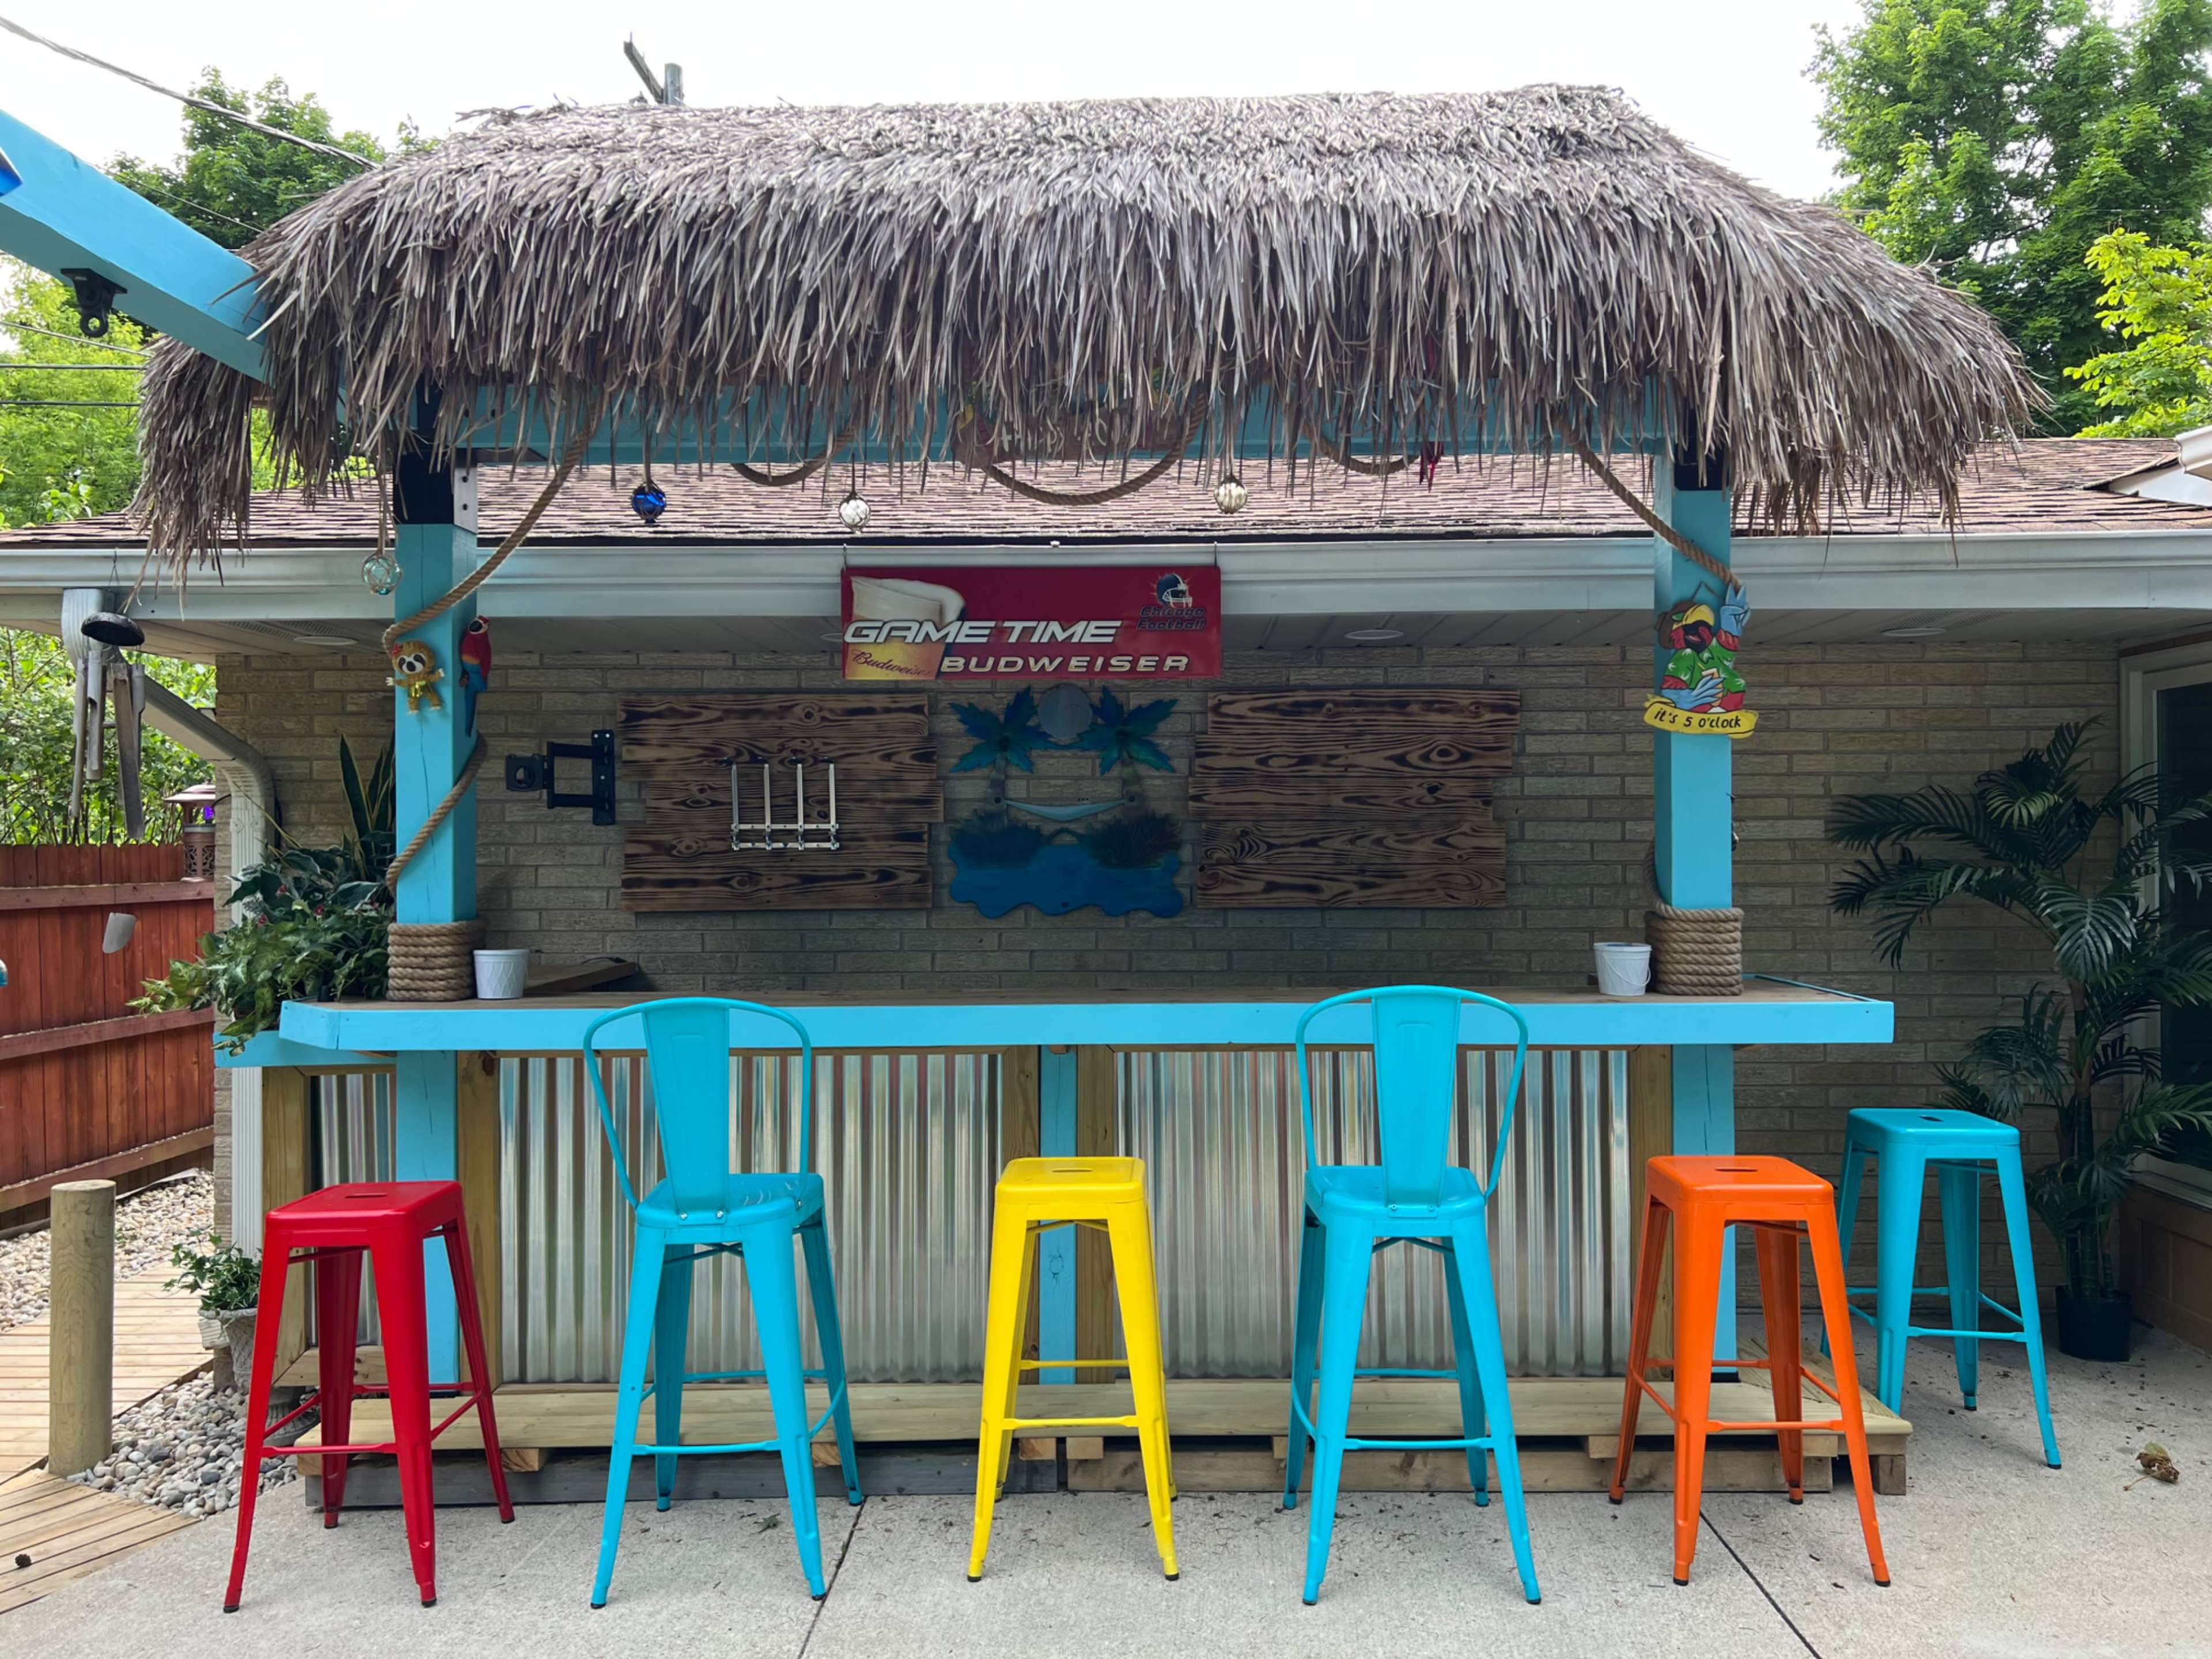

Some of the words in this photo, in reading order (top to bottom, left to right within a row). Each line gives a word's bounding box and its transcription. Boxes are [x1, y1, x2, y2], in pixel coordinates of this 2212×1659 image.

[1140, 606, 1205, 619] Chicago
[844, 620, 997, 643] GAME
[1002, 620, 1122, 643] TIME
[1136, 618, 1206, 631] Football
[852, 649, 932, 676] Budweiser
[940, 656, 1190, 672] BUDWEISER
[1654, 707, 1679, 724] it's
[1683, 716, 1694, 728] 5
